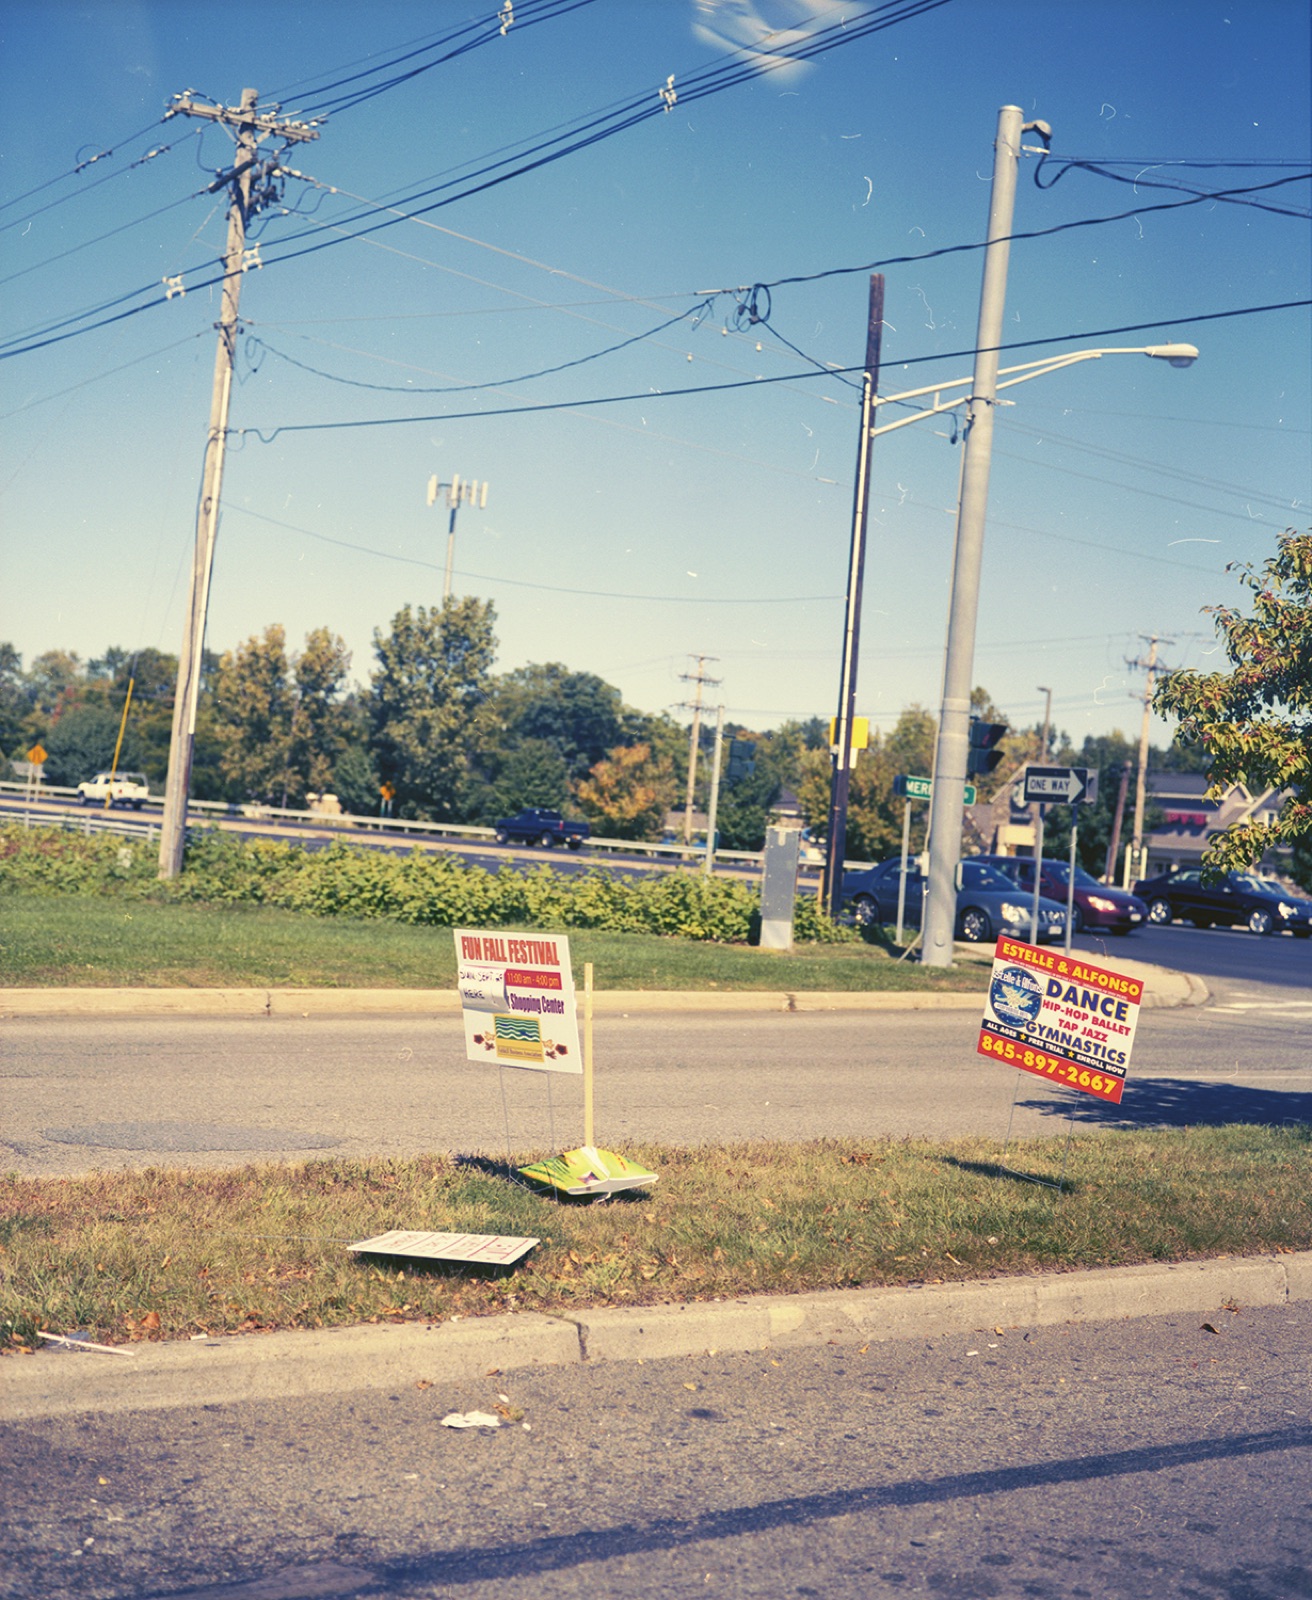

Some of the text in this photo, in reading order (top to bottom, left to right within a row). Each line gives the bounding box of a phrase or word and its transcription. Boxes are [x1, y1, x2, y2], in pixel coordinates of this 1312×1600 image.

[1030, 779, 1070, 792] ONE WAY
[461, 936, 560, 966] FUN FALL FESTIVAL
[1002, 942, 1055, 969] ESTELLE
[1057, 961, 1069, 974] &
[1071, 966, 1140, 996] ALFONSO
[507, 972, 523, 984] 11:00
[522, 975, 532, 984] am
[536, 974, 548, 986] 4:00
[548, 977, 560, 988] pm
[510, 993, 565, 1014] Shopping Center
[1042, 999, 1089, 1021] HIP-HOP
[1091, 1016, 1131, 1036] BALLET
[1045, 978, 1129, 1022] DANCE
[986, 1022, 1125, 1075] ALL AGES FREE TRIAL ENROLL NOW
[1025, 1020, 1126, 1065] GYMNASTICS
[1058, 1018, 1109, 1043] TAP JAZZ
[981, 1035, 1117, 1094] 845-897-2667
